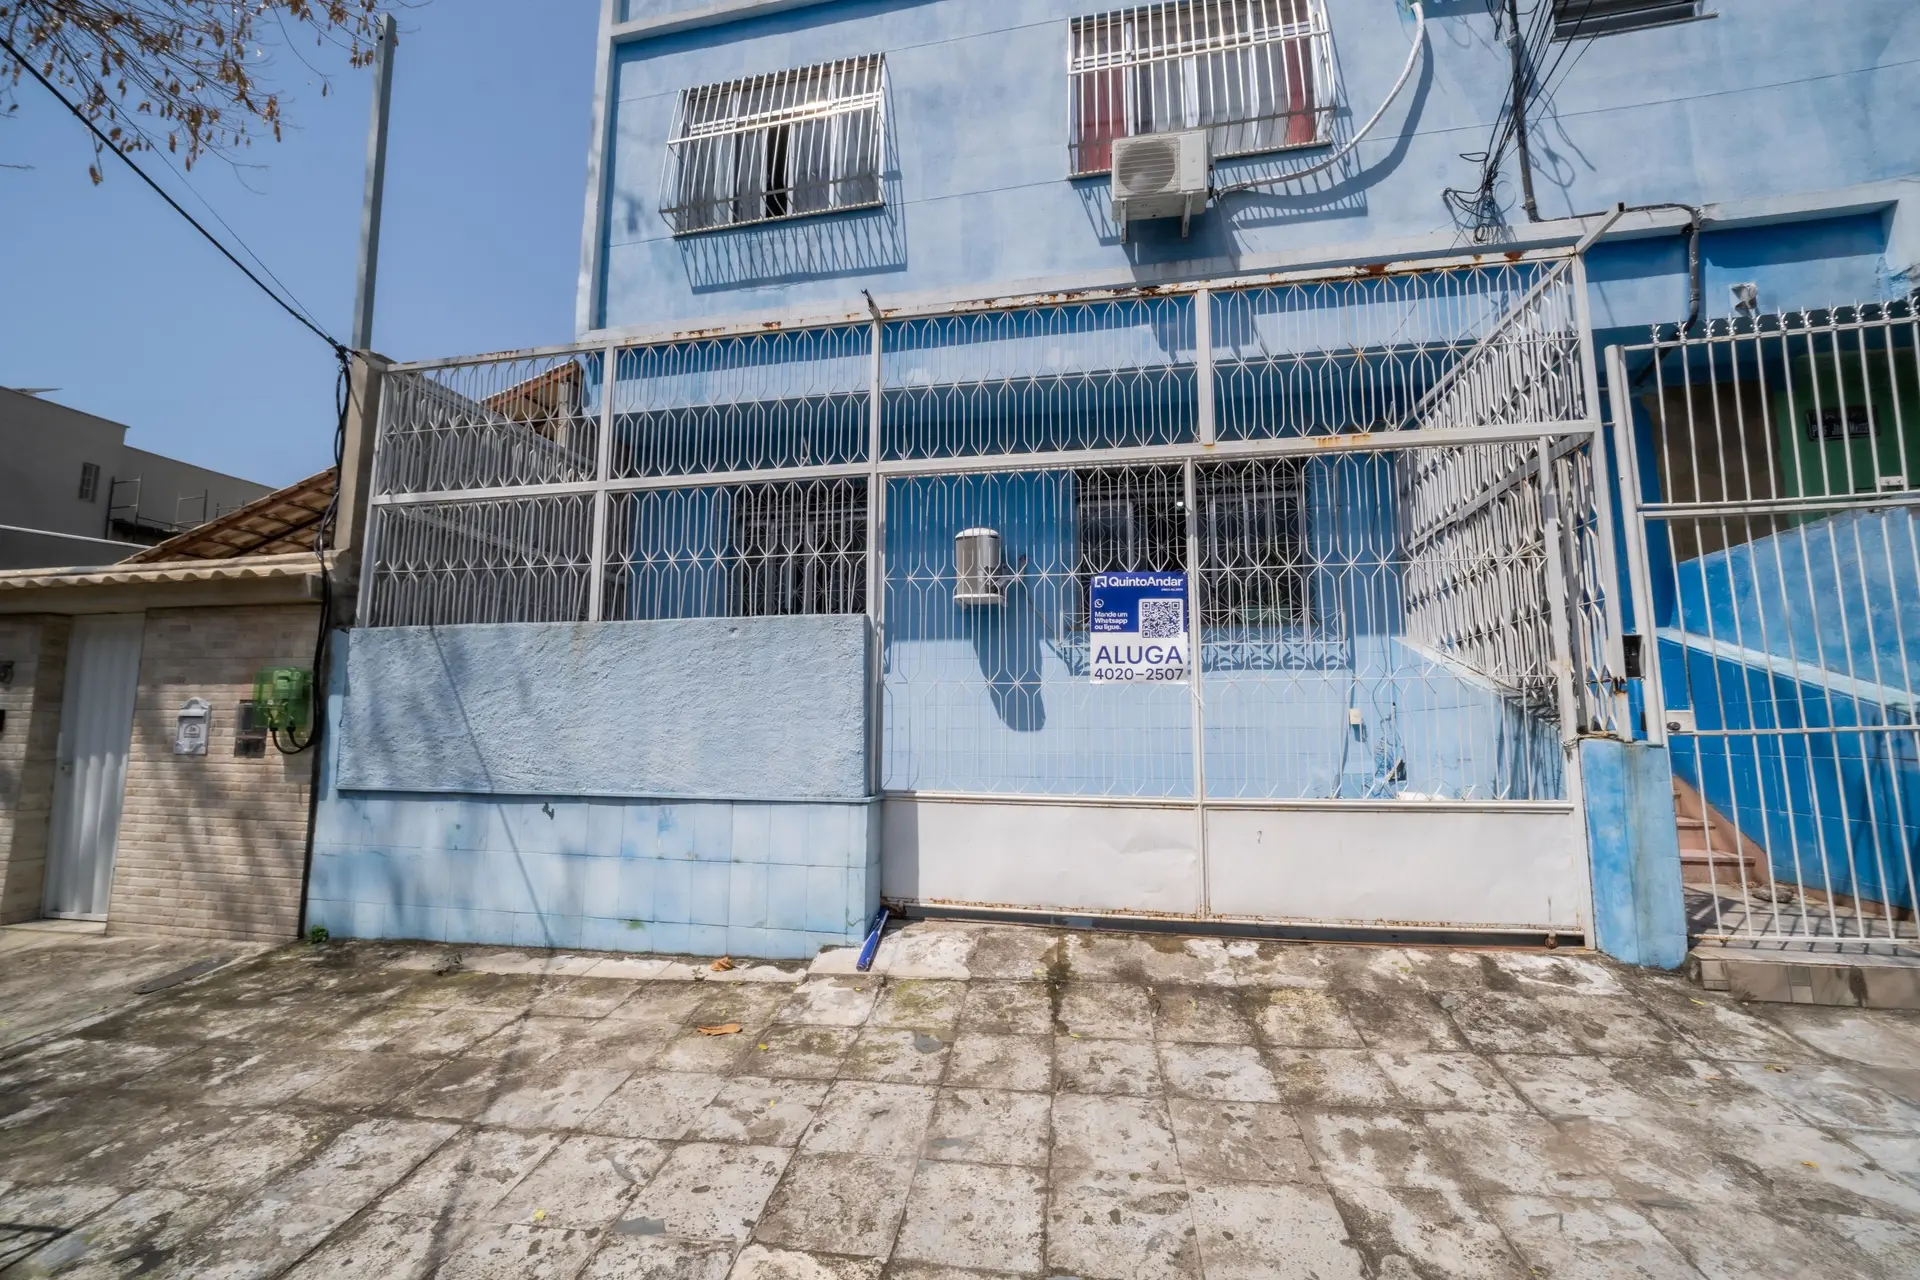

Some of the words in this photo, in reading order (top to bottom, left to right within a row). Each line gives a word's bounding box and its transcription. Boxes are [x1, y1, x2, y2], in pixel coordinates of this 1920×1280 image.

[1108, 576, 1183, 587] QuintoAndar
[1095, 645, 1183, 664] ALUGA
[1094, 668, 1184, 680] 4020-2507
